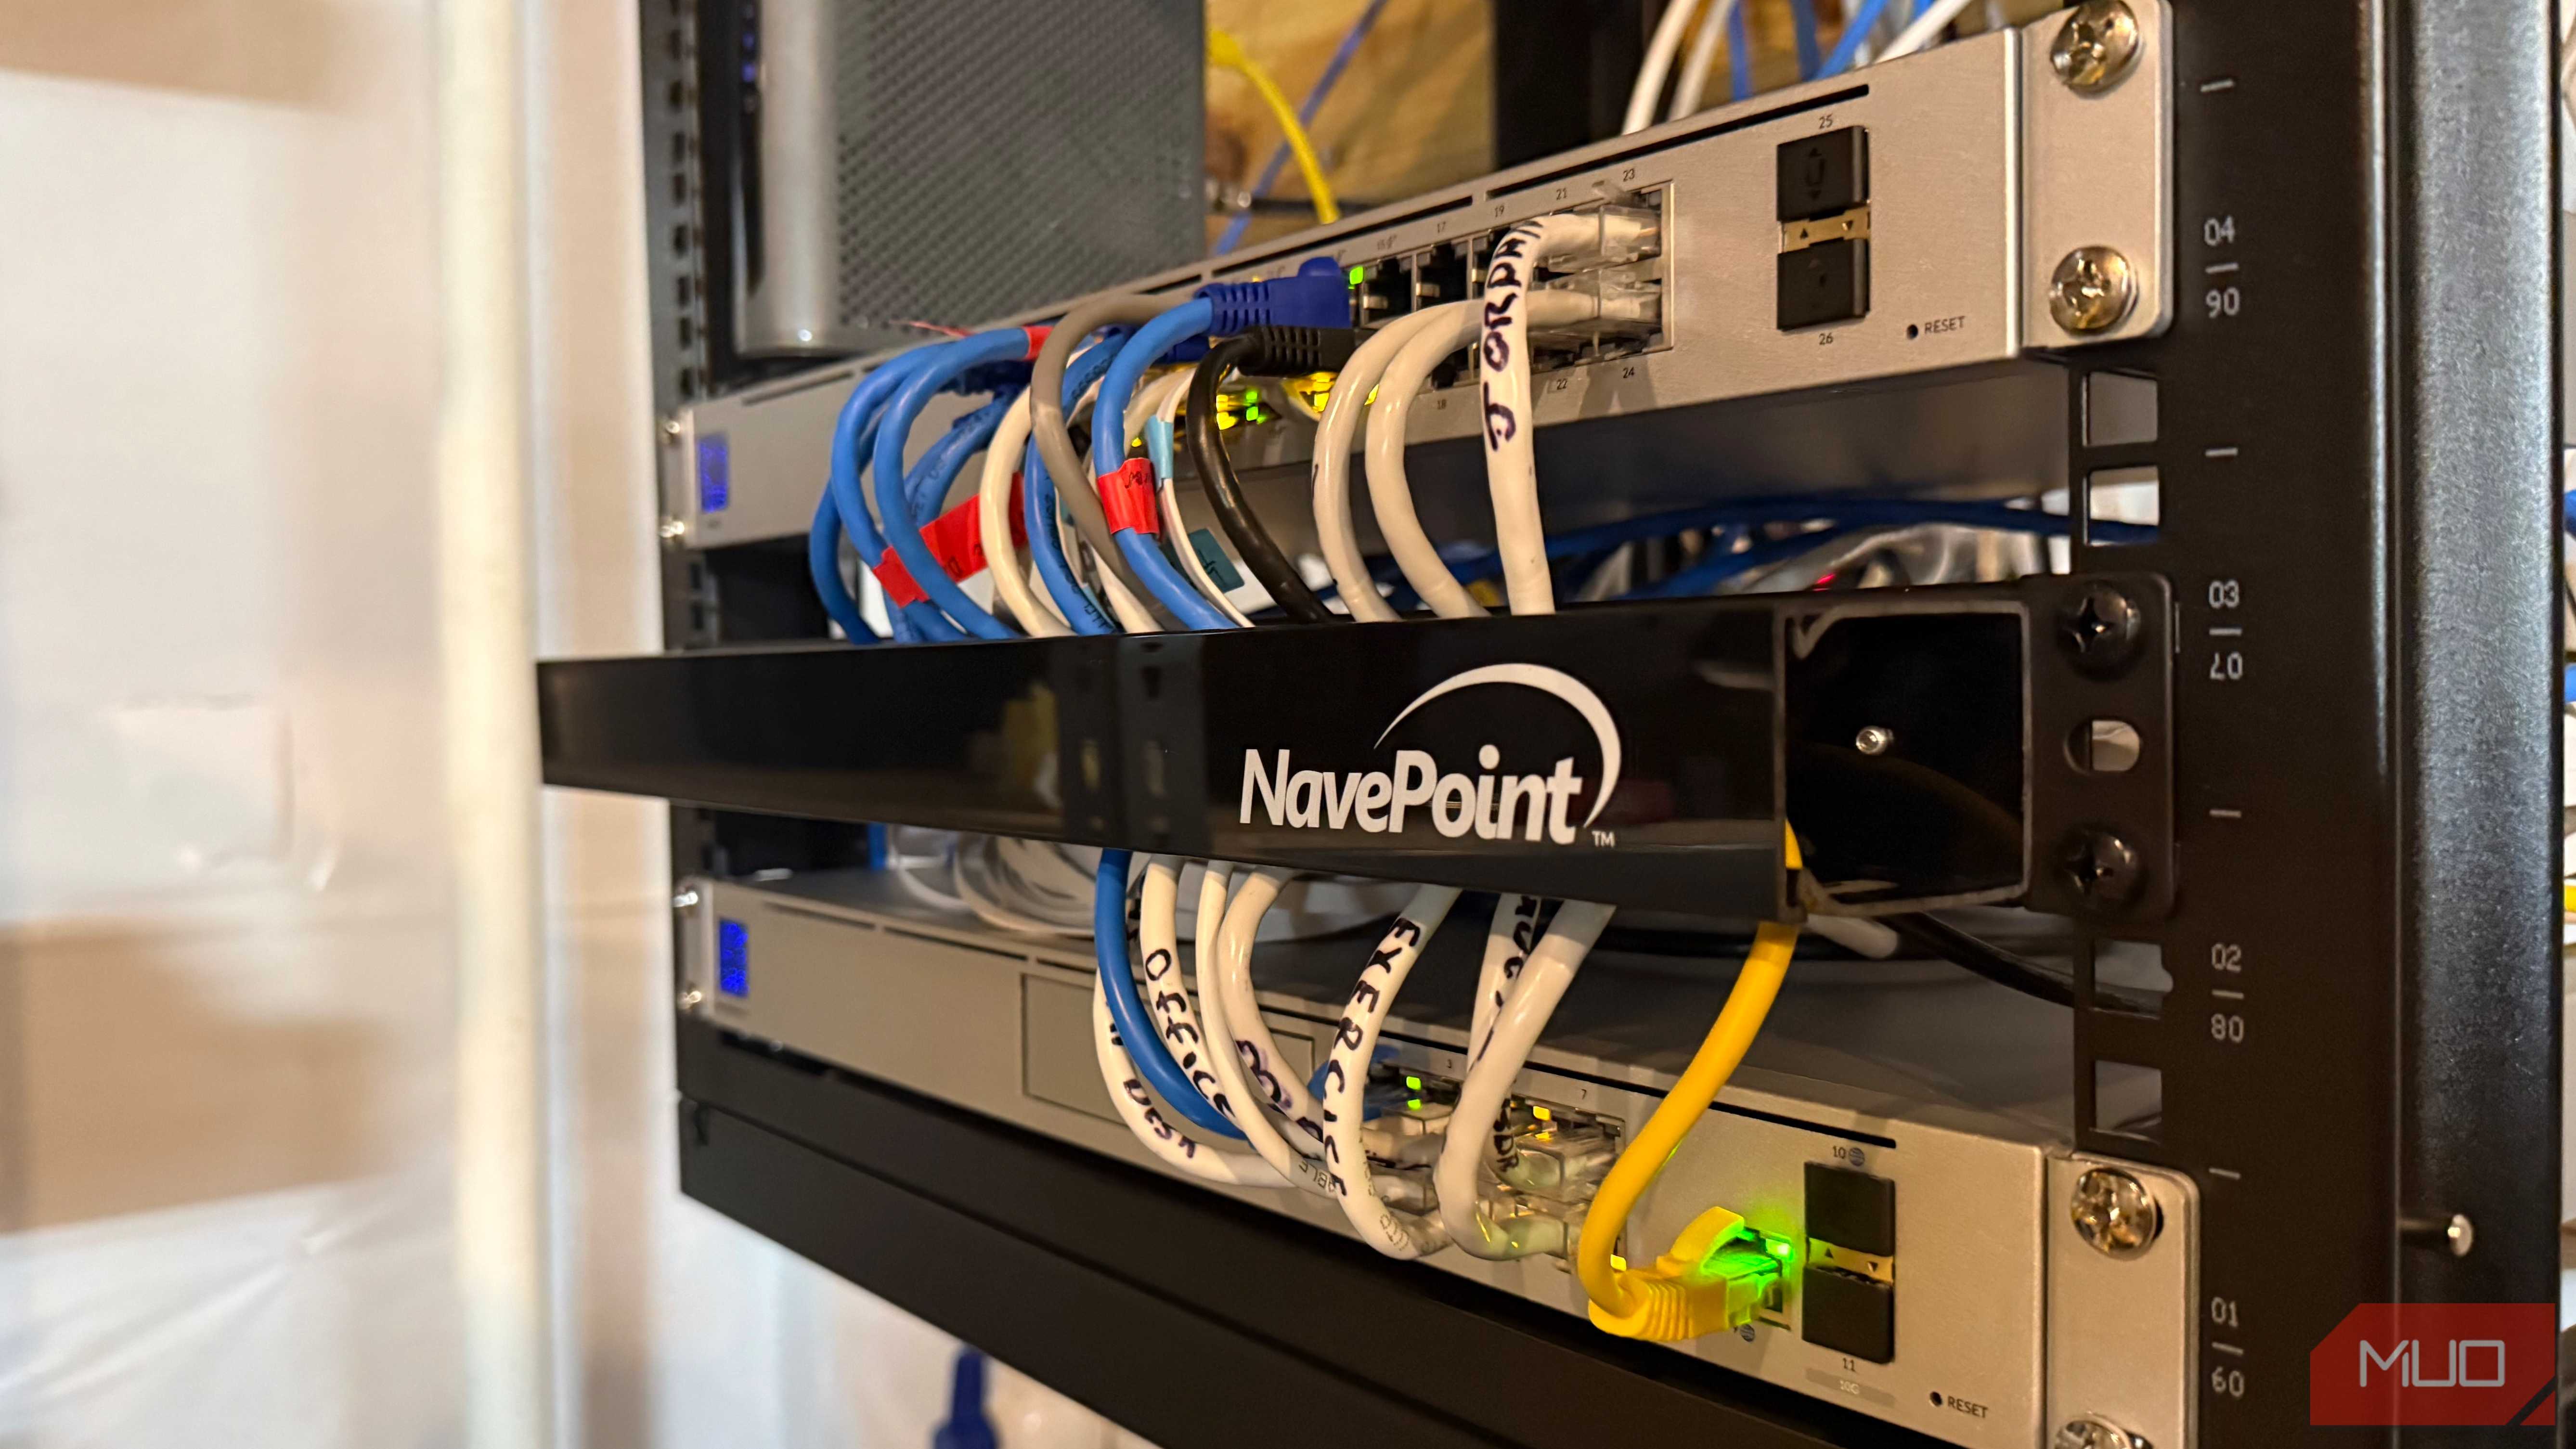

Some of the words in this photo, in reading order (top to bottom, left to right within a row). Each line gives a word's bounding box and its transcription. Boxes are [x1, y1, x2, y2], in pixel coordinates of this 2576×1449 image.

[1818, 113, 1833, 129] 25
[1622, 167, 1636, 182] 23
[1555, 187, 1568, 201] 21
[1494, 204, 1505, 218] 19
[1437, 220, 1447, 234] 17
[2203, 215, 2235, 246] 04
[1924, 314, 1967, 335] RESET
[1819, 332, 1834, 346] 26
[1622, 366, 1635, 379] 24
[1556, 377, 1568, 391] 22
[1437, 399, 1447, 411] 18
[2208, 579, 2240, 609] 03
[1239, 744, 1583, 845] NavePoint
[2211, 943, 2242, 972] 02
[1446, 1058, 1452, 1069] 3
[1580, 1088, 1587, 1100] 7
[1832, 1145, 1847, 1160] 10
[2210, 1296, 2239, 1328] 01
[1843, 1357, 1856, 1372] 11
[1947, 1395, 1989, 1420] RESET
